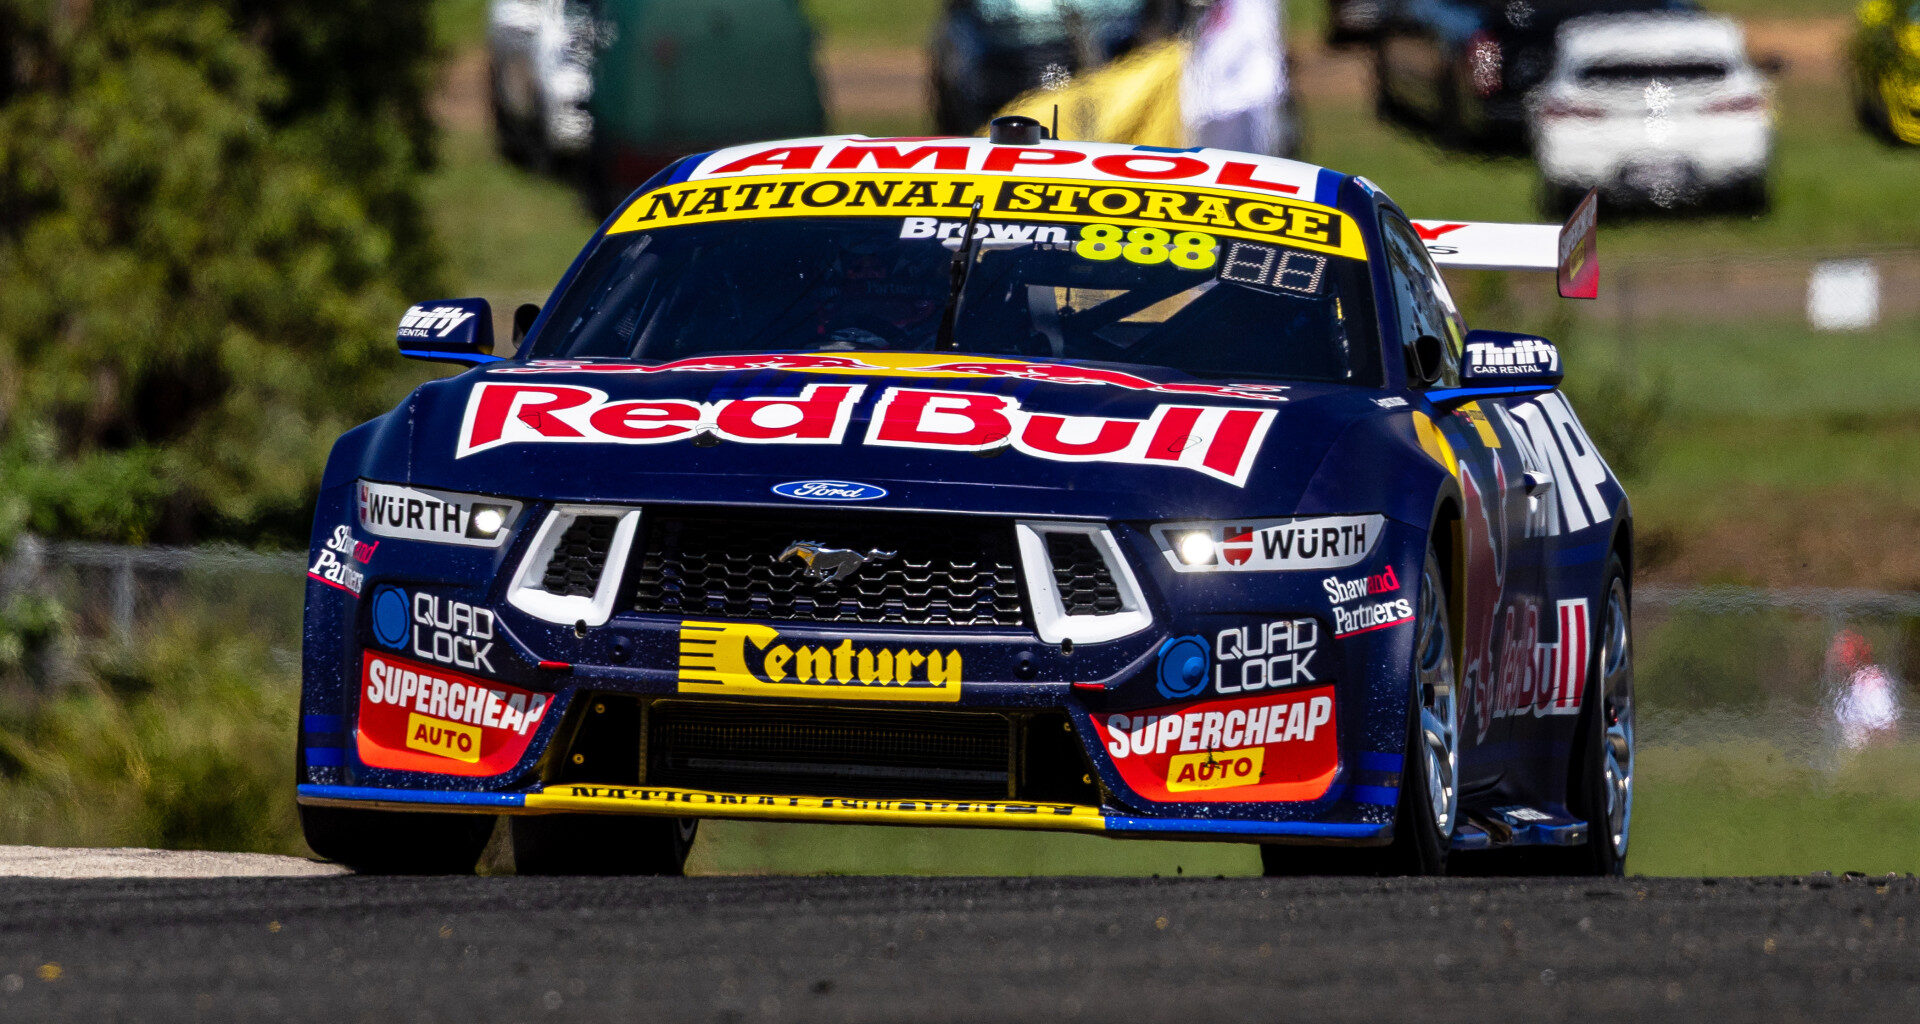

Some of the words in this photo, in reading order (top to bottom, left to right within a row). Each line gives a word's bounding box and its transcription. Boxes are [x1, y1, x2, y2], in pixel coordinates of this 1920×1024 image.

[708, 146, 1300, 195] AMPOL
[637, 180, 983, 223] NATIONAL
[1008, 184, 1331, 243] STORAGE
[900, 217, 1068, 243] Brown
[1076, 224, 1217, 270] 888
[1466, 340, 1558, 372] Thrifty
[1473, 366, 1498, 374] CAR
[1499, 364, 1542, 374] RENTAL
[455, 381, 868, 459] Red
[864, 386, 1279, 488] Bull
[793, 482, 865, 498] Ford
[414, 592, 496, 640] QUAD
[1216, 617, 1318, 661] QUAD
[1332, 598, 1412, 634] Partners
[413, 625, 496, 673] LOCK
[702, 620, 962, 694] Century
[1215, 650, 1316, 694] LOCK
[367, 659, 548, 735] SUPERCHEAP
[414, 724, 473, 753] AUTO
[1106, 696, 1332, 758] SUPERCHEAP
[1176, 757, 1253, 783] AUTO
